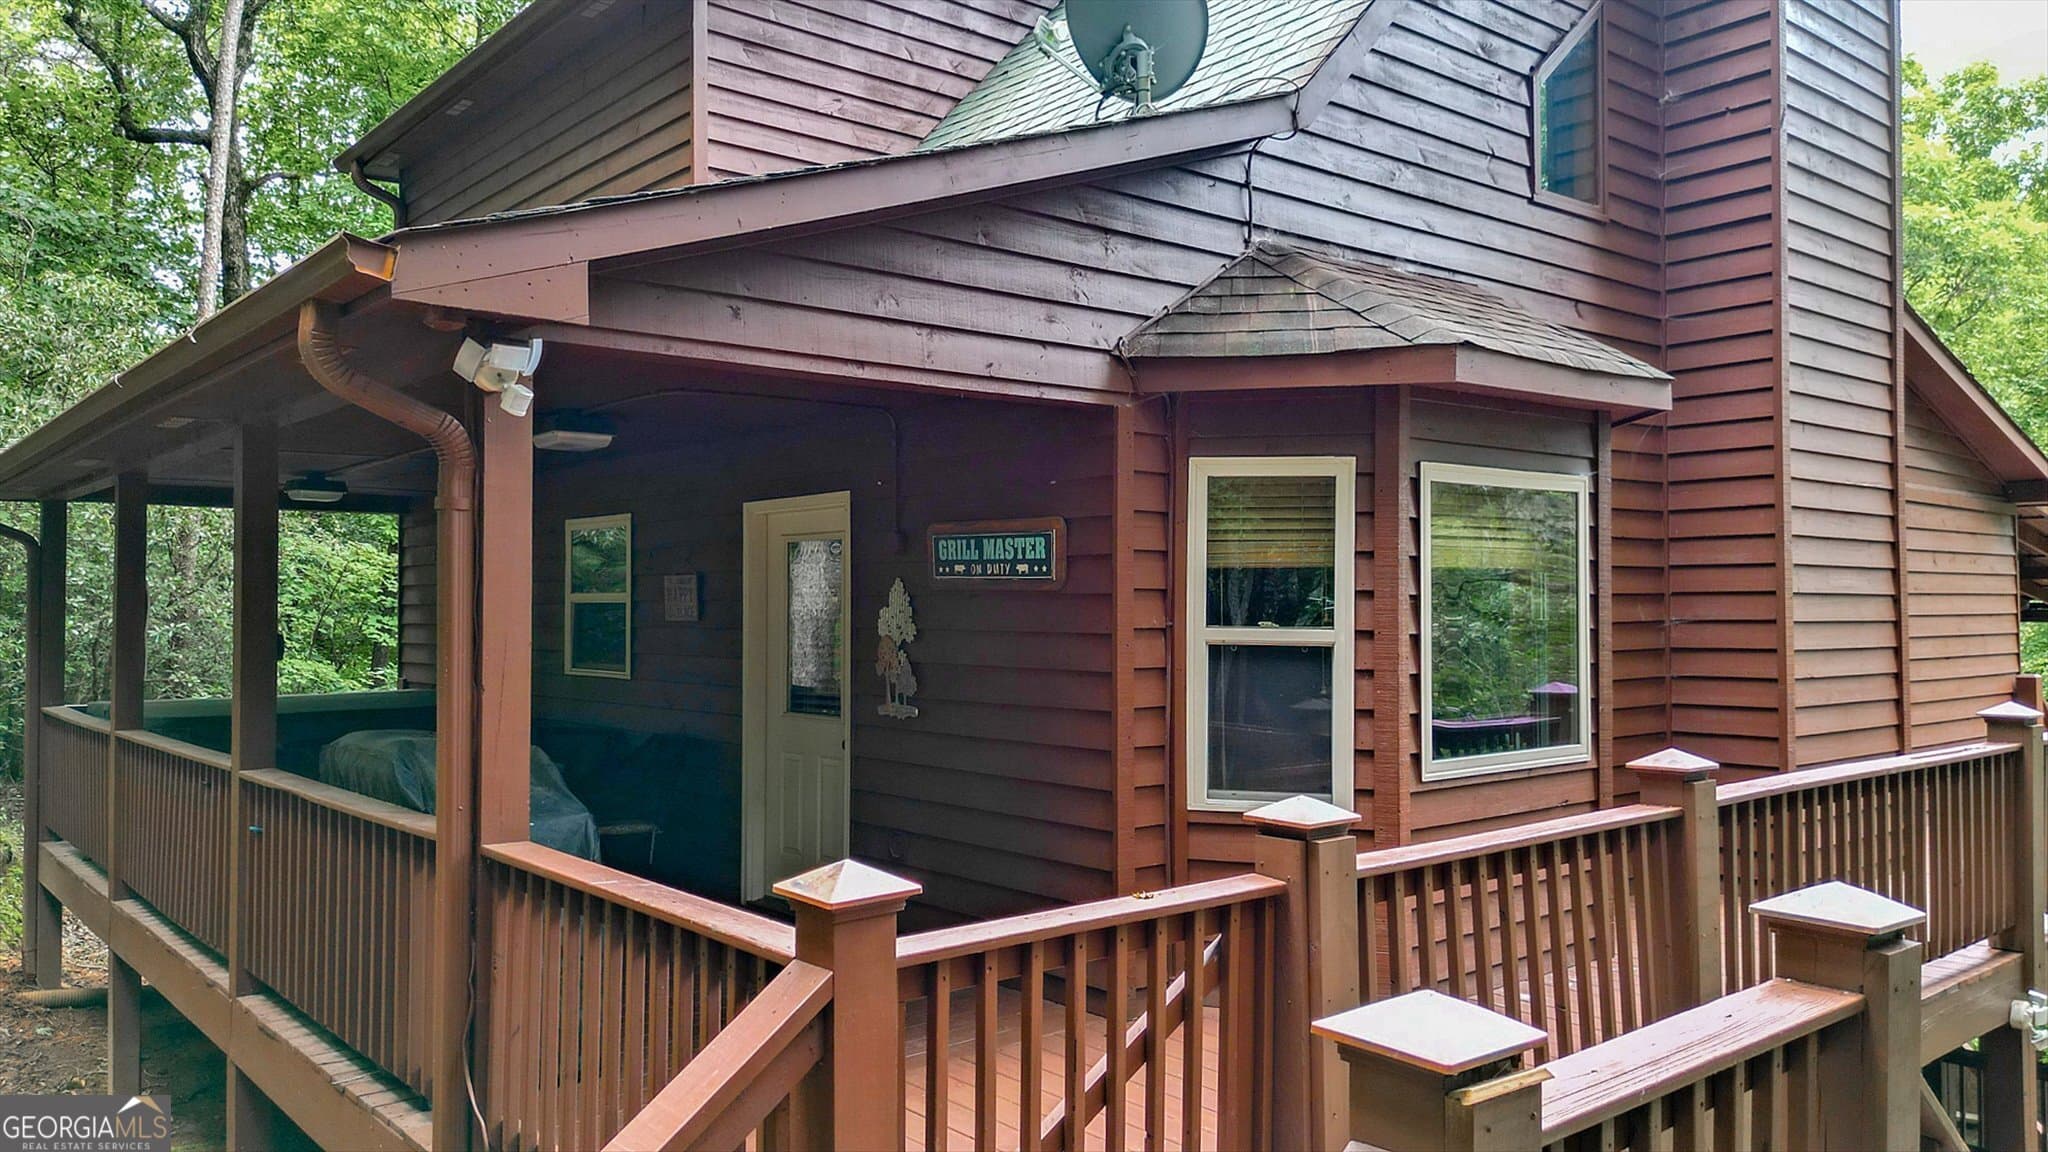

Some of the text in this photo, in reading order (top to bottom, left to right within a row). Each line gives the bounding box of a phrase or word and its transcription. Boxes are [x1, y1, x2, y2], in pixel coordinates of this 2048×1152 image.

[938, 537, 1046, 561] GRILL MASTER
[970, 563, 1011, 575] ON DUTY
